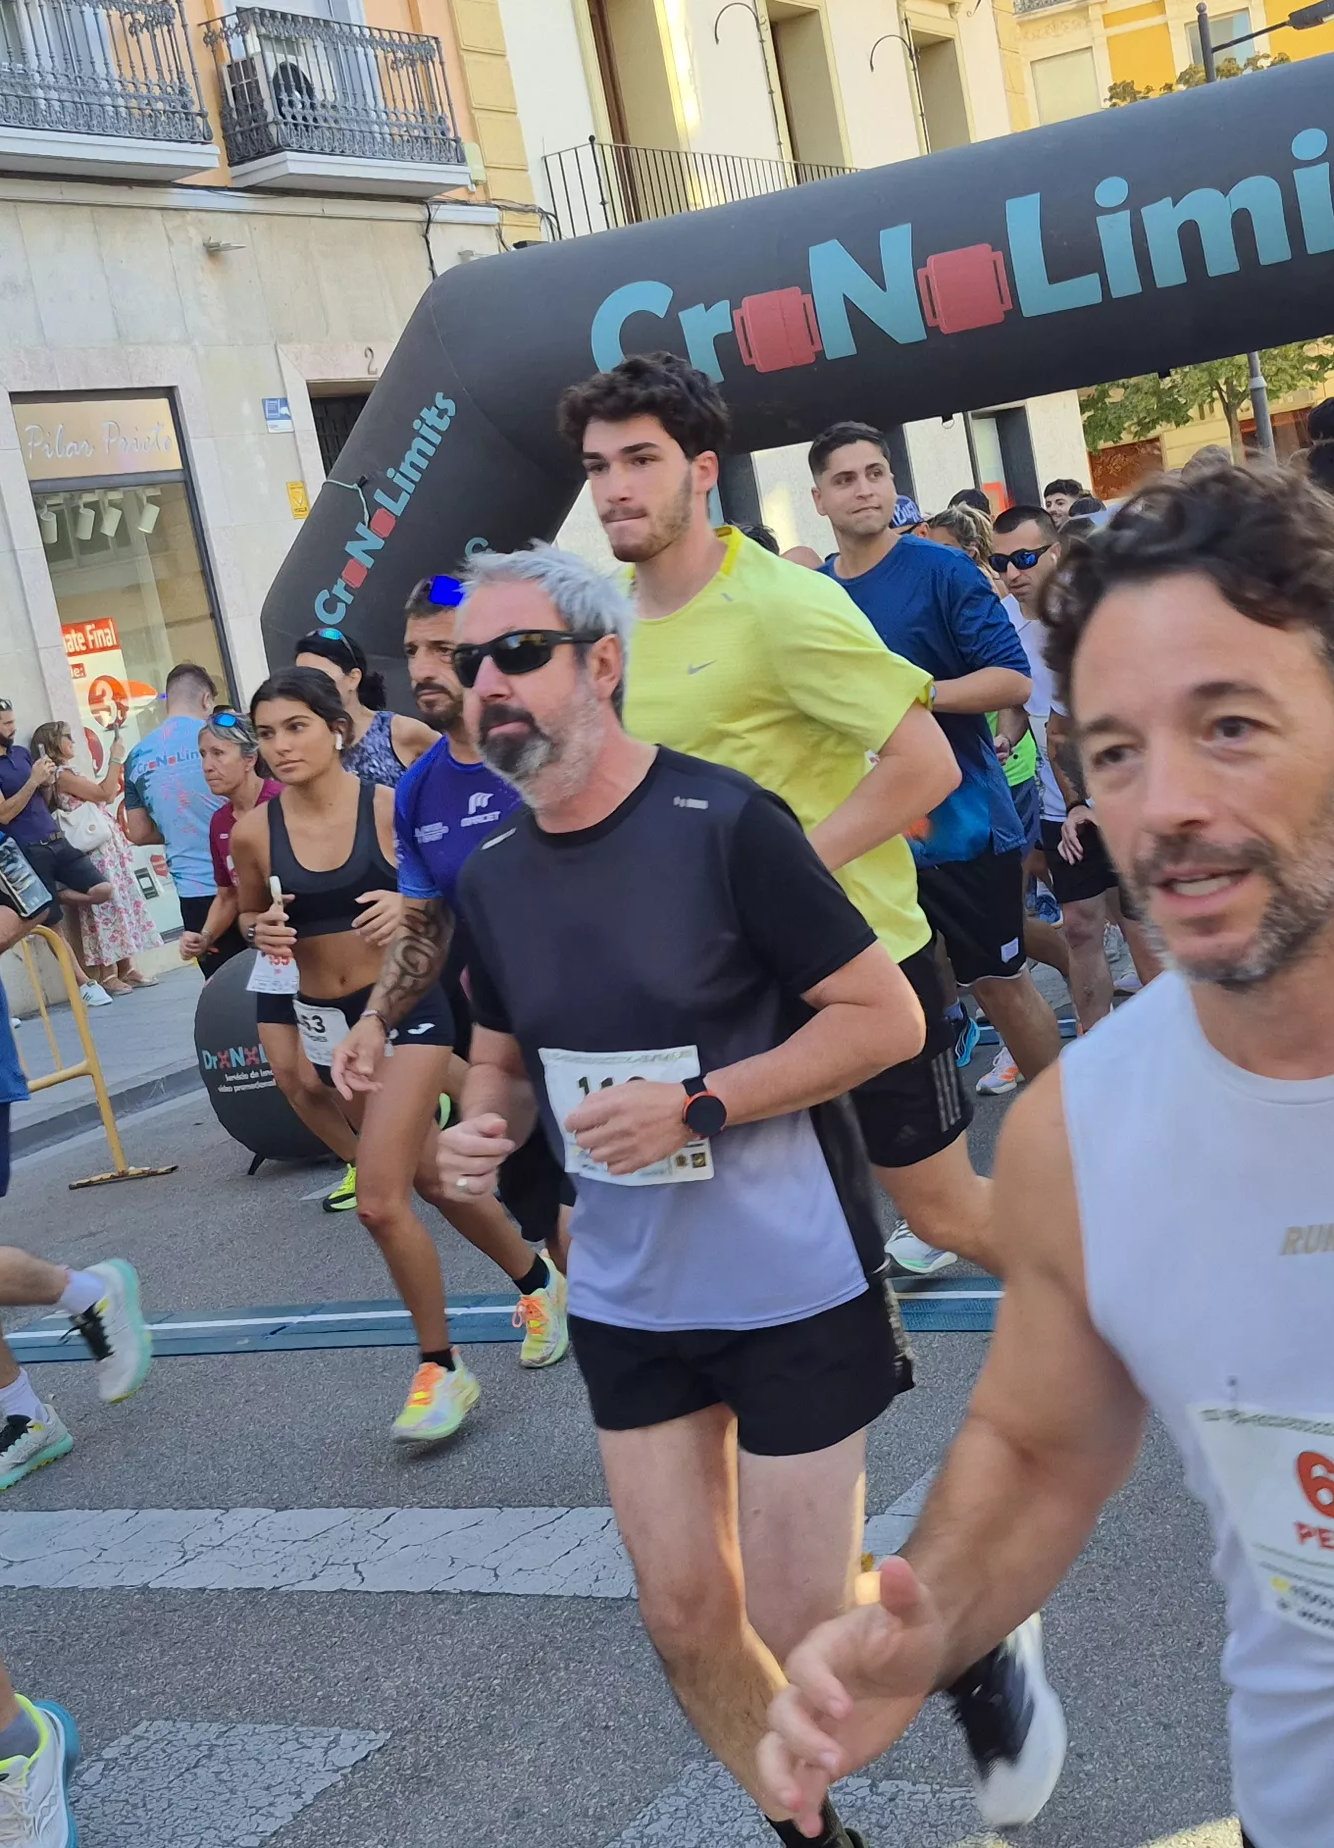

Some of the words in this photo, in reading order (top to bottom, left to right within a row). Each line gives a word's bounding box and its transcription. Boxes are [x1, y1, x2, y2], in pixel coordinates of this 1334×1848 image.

[365, 347, 378, 374] 2
[25, 424, 95, 460] Pilar
[101, 420, 173, 455] Prieto
[85, 621, 117, 649] Final
